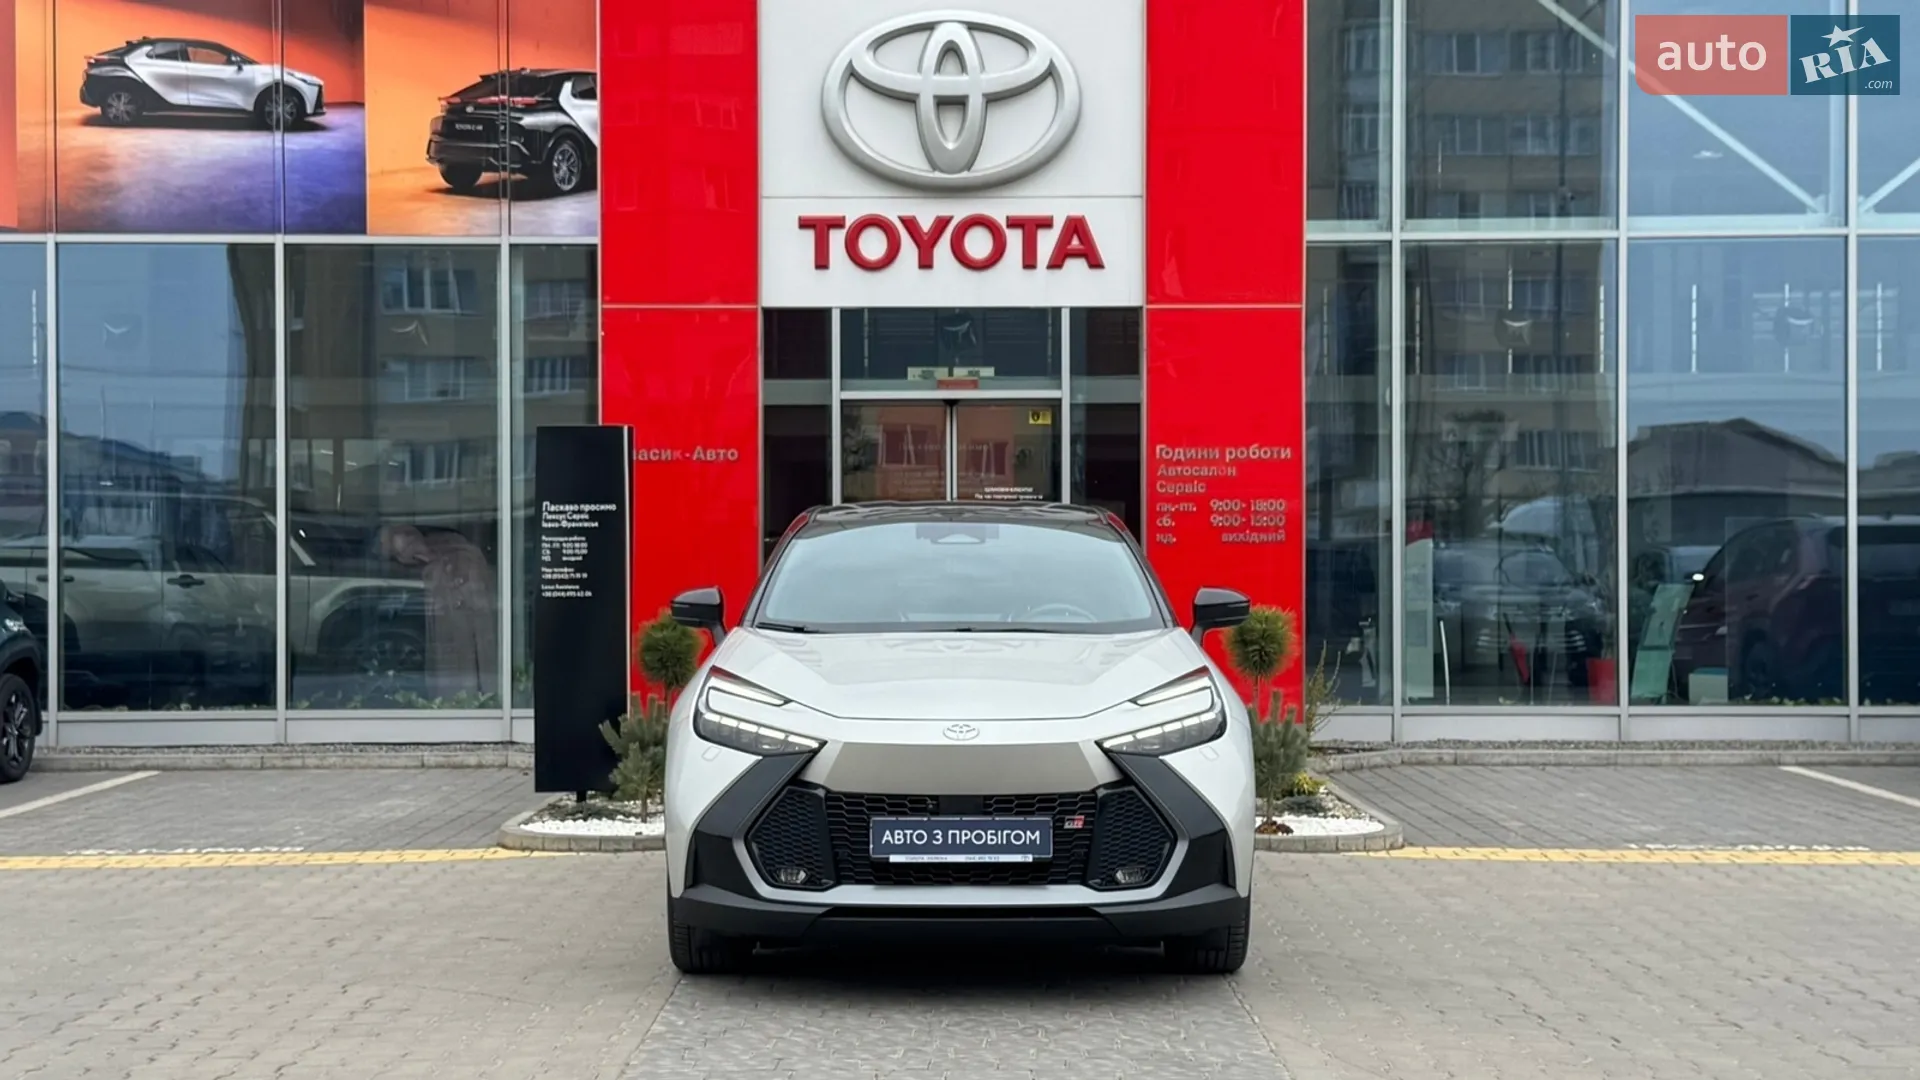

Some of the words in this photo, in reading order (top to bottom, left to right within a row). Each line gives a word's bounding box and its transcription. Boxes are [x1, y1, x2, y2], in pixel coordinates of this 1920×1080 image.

[798, 213, 1105, 271] TOYOTA
[632, 445, 739, 461] асик-Авто
[1155, 444, 1220, 461] Години
[1225, 443, 1292, 463] роботи
[1157, 464, 1237, 477] Автосалон
[1156, 480, 1207, 495] Сервіс
[580, 504, 617, 512] просимо
[881, 829, 928, 845] АВТО
[932, 830, 943, 845] З
[947, 829, 1041, 845] ПРОБІГОМ
